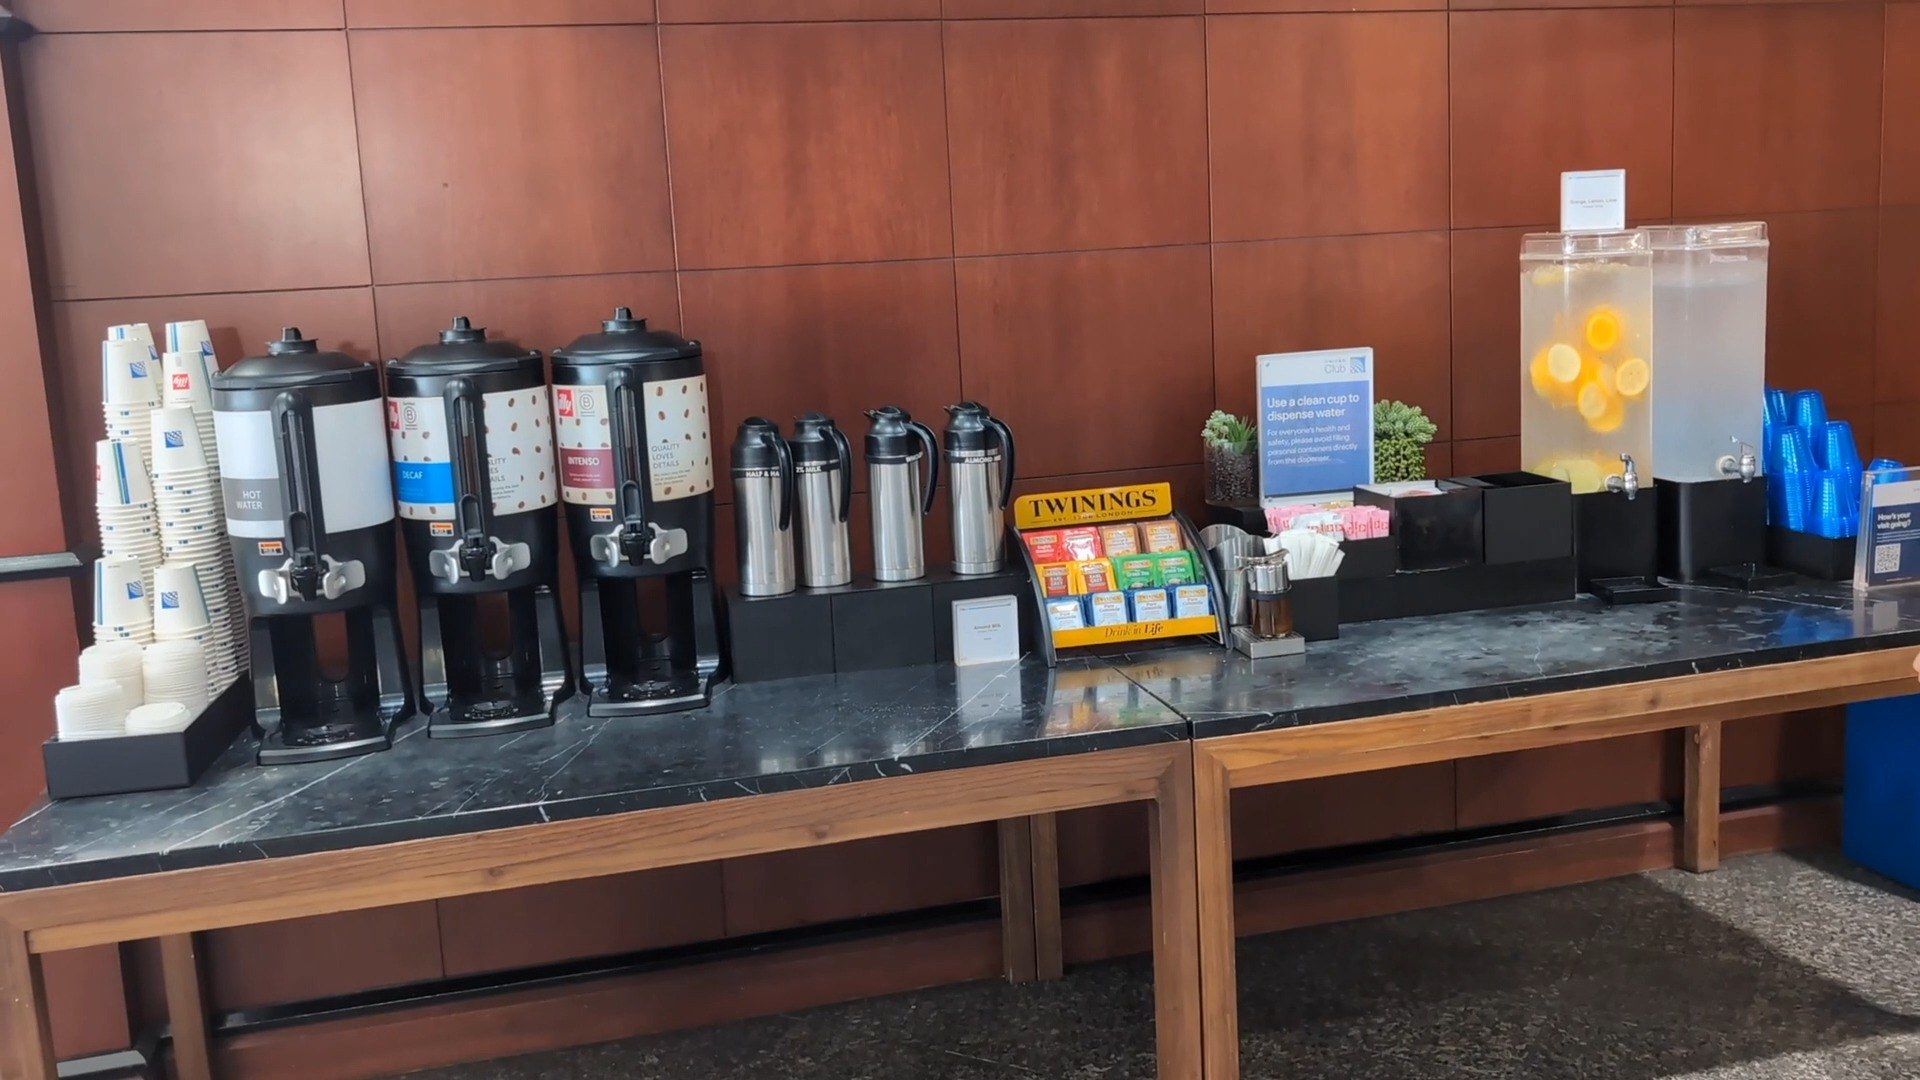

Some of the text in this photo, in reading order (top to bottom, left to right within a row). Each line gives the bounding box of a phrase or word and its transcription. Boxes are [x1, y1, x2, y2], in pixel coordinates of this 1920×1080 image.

[1324, 364, 1346, 374] Club
[1267, 398, 1287, 408] Use
[1297, 395, 1325, 407] clean
[1327, 395, 1347, 405] cup
[1349, 394, 1360, 403] to
[1267, 408, 1346, 422] dispense water
[1279, 427, 1315, 436] everyone's
[1315, 425, 1336, 433] health
[1337, 424, 1351, 432] and
[1291, 437, 1313, 446] please
[1314, 435, 1332, 443] avoid
[1333, 434, 1350, 442] filling
[652, 443, 680, 452] QUALITY
[1267, 443, 1358, 457] personal containers directly
[567, 456, 600, 466] INTENSO
[653, 453, 674, 461] LOVES
[653, 460, 679, 469] DETAILS
[806, 465, 822, 473] MILK
[402, 470, 423, 480] DECAF
[745, 470, 763, 478] HALF
[242, 490, 261, 499] HOT
[236, 500, 263, 510] WATER
[1029, 488, 1157, 517] TWININGS
[1096, 510, 1134, 518] LONDON
[1878, 512, 1911, 521] How's your
[1891, 519, 1911, 529] going?
[1104, 623, 1164, 638] Drink in Life
